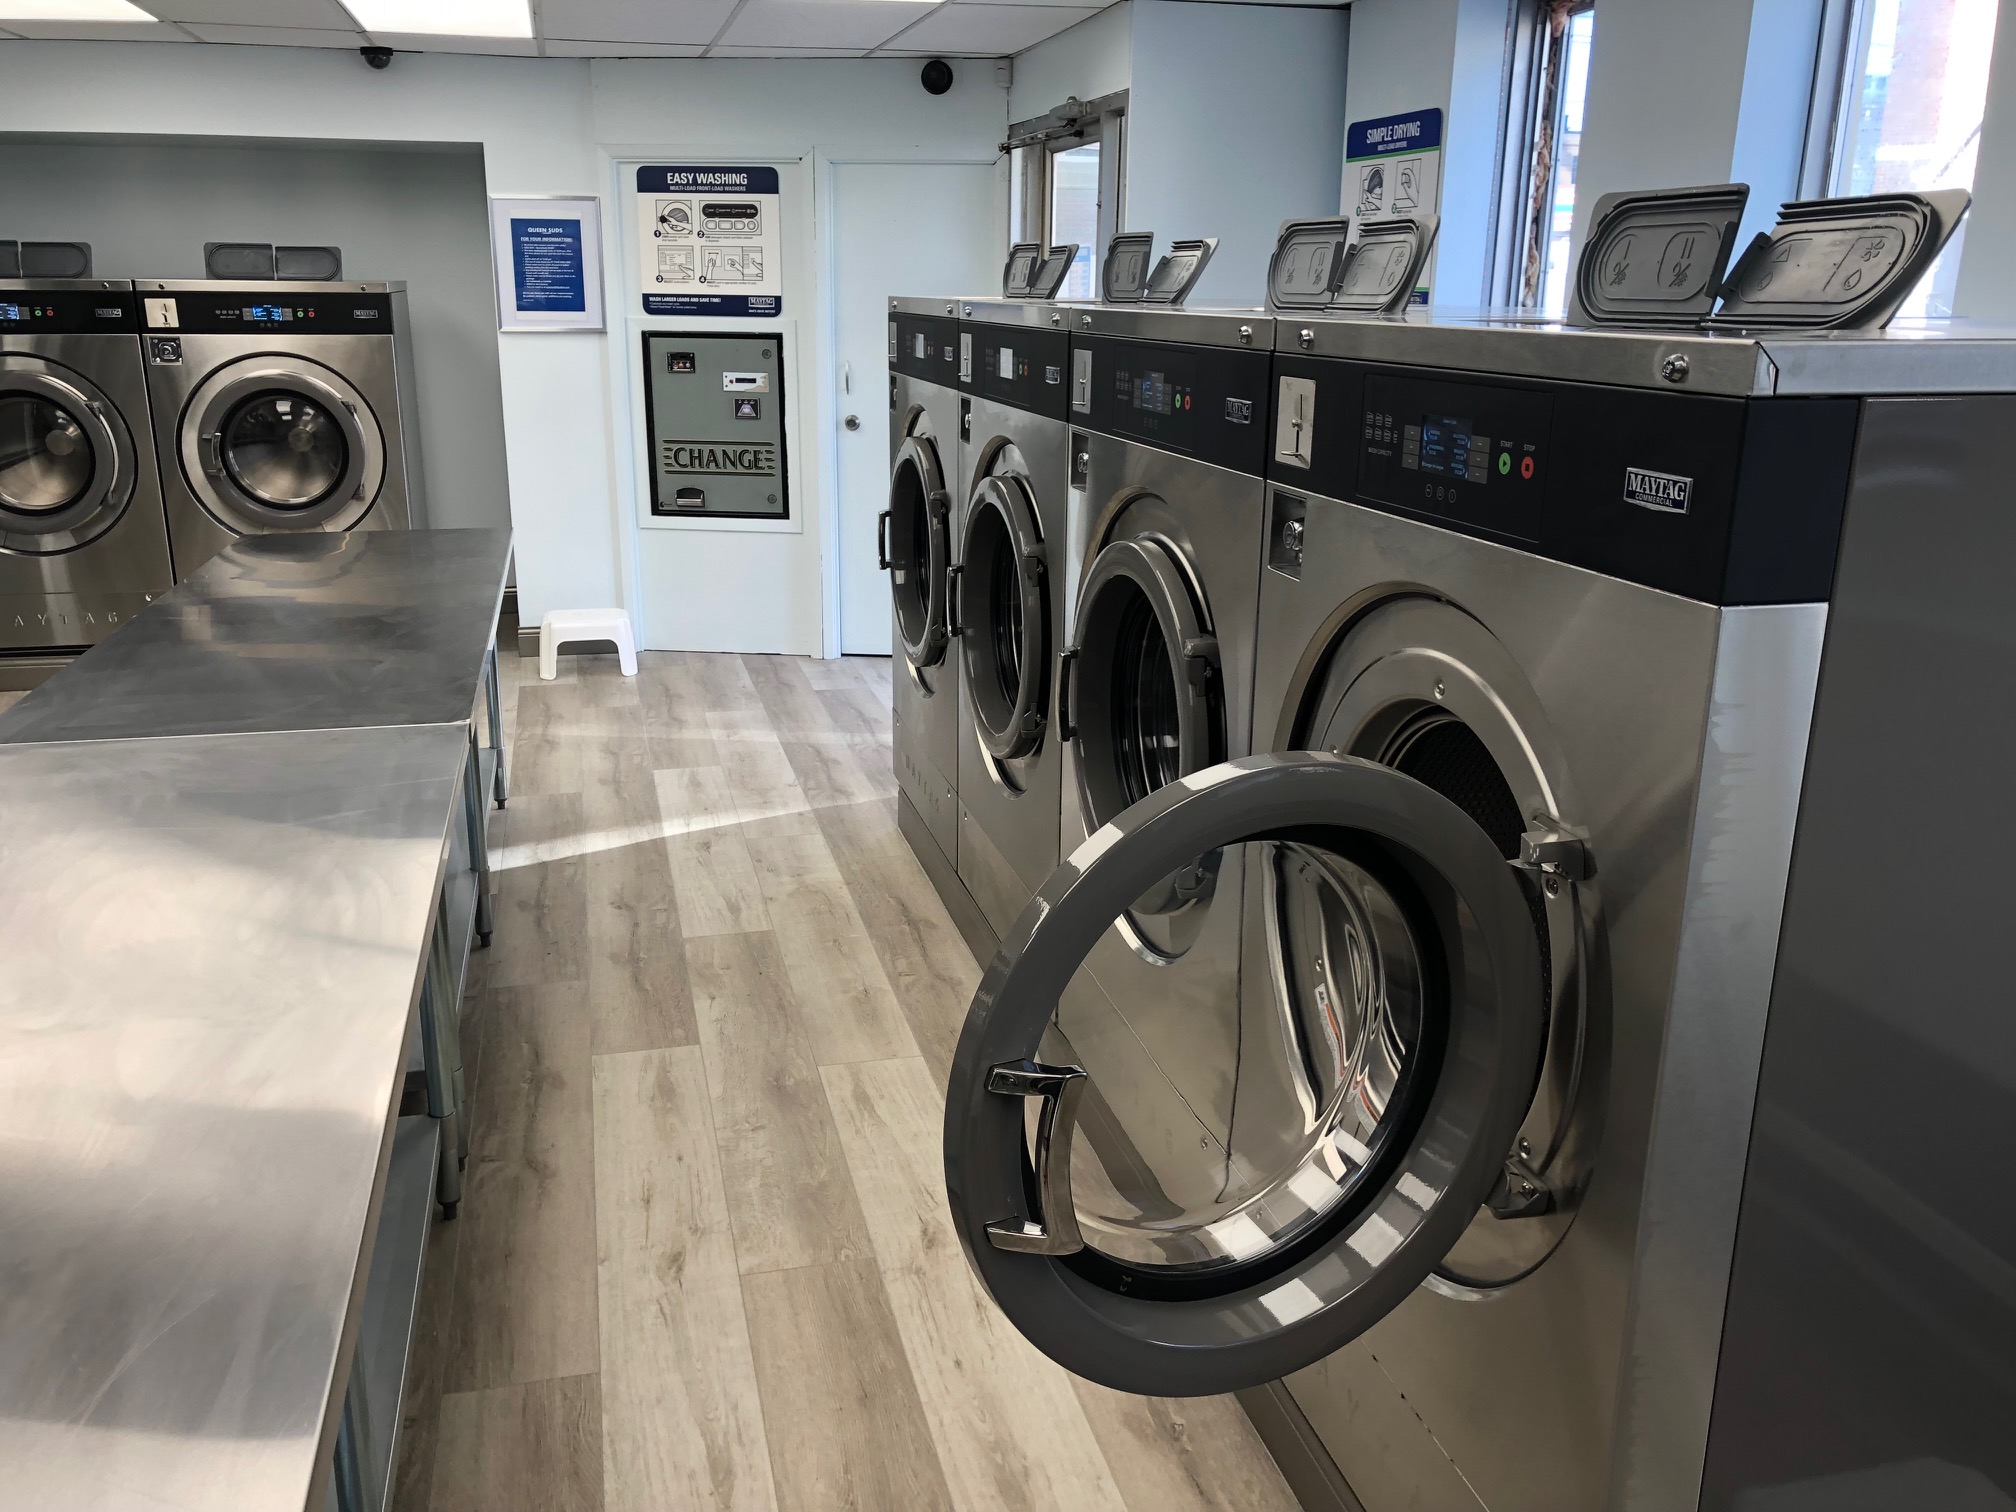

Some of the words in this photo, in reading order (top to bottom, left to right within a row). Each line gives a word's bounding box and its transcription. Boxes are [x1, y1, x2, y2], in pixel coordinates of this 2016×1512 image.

[1366, 126, 1392, 143] SIMPLE
[1393, 121, 1420, 139] DRYING
[667, 172, 694, 184] EASY
[696, 172, 748, 185] WASHING
[1227, 401, 1249, 416] MAYTAG
[1500, 440, 1514, 449] START
[1523, 444, 1536, 452] STOP
[673, 447, 766, 470] CHANGE
[1628, 473, 1685, 501] MAYTAG
[1635, 492, 1673, 507] COMMERCIAL
